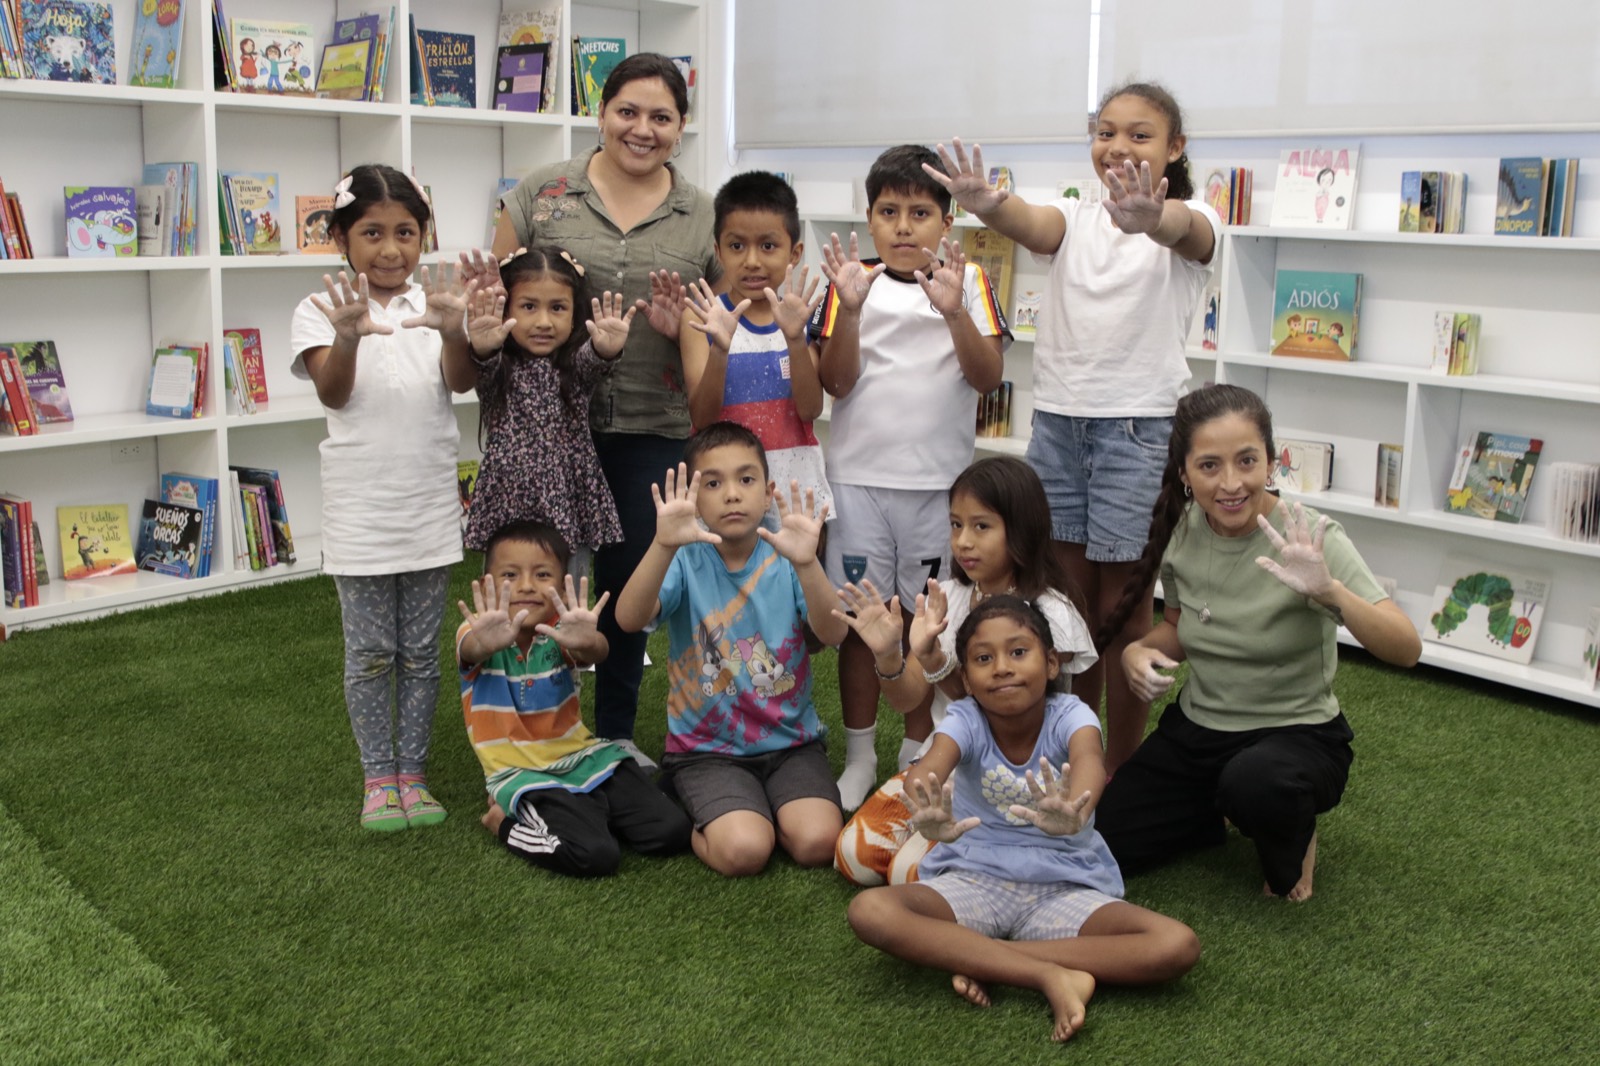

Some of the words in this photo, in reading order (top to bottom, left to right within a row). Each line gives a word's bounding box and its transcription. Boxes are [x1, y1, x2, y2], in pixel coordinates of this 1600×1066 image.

[45, 8, 87, 34] Hoja
[425, 40, 468, 56] TRILLÓN
[428, 55, 473, 67] ESTRELLAS
[1283, 149, 1350, 179] ALMA
[92, 191, 130, 207] salvajes
[1287, 288, 1341, 310] ADIÓS
[155, 506, 190, 531] SUEÑOS
[154, 525, 183, 545] ORCAS
[921, 556, 941, 595] 7
